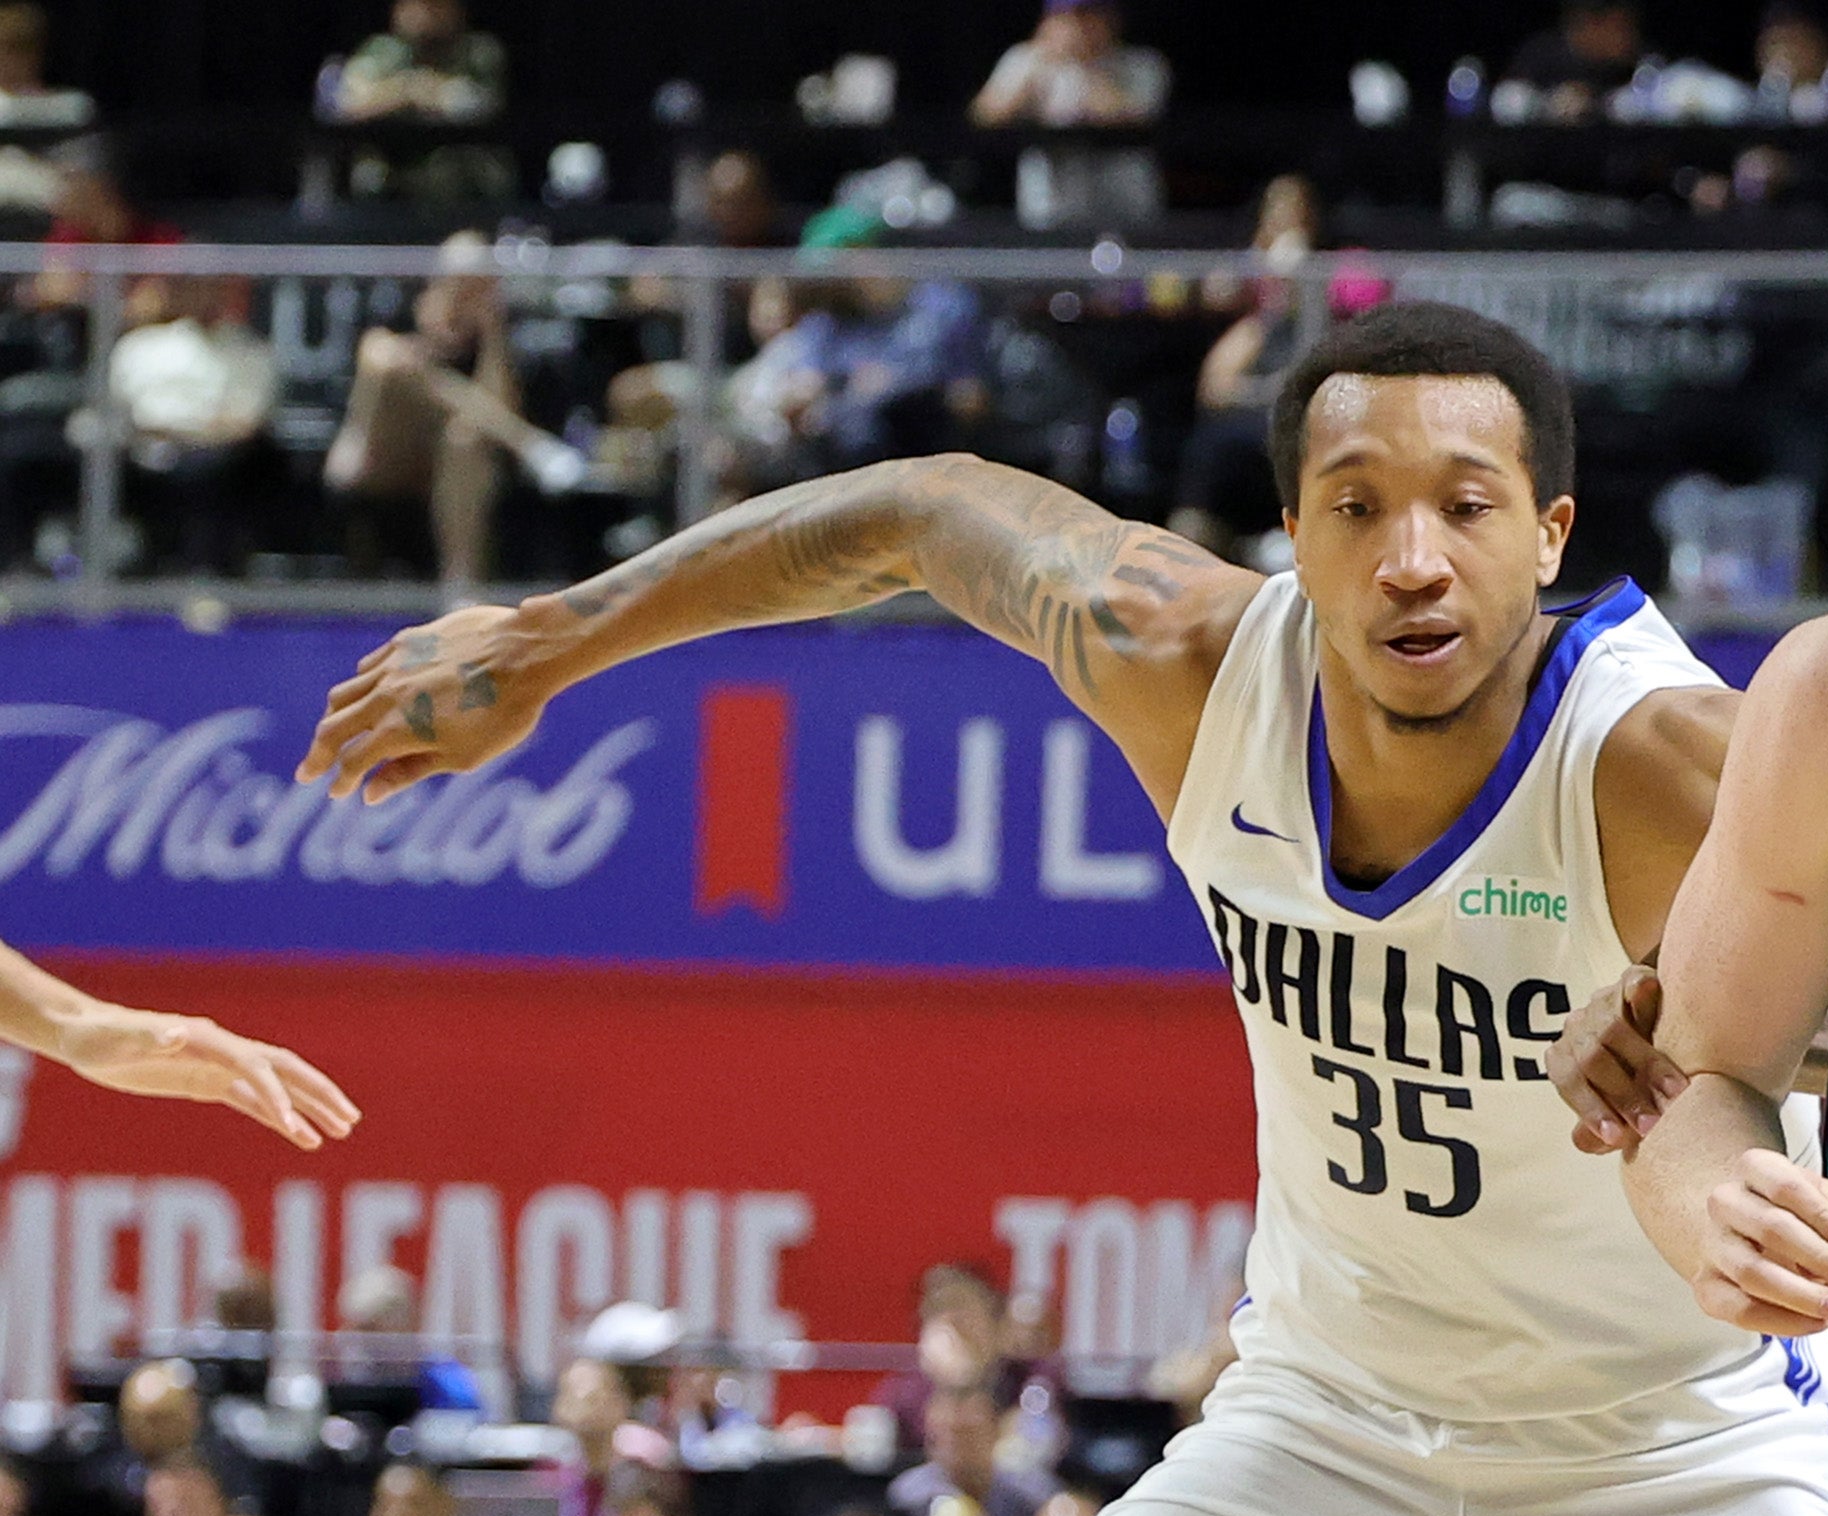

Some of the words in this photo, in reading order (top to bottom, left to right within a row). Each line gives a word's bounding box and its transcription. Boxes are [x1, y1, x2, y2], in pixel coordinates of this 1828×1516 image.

[1208, 883, 1572, 1082] DALLAS
[1459, 877, 1567, 923] chime
[1311, 1053, 1482, 1218] 35
